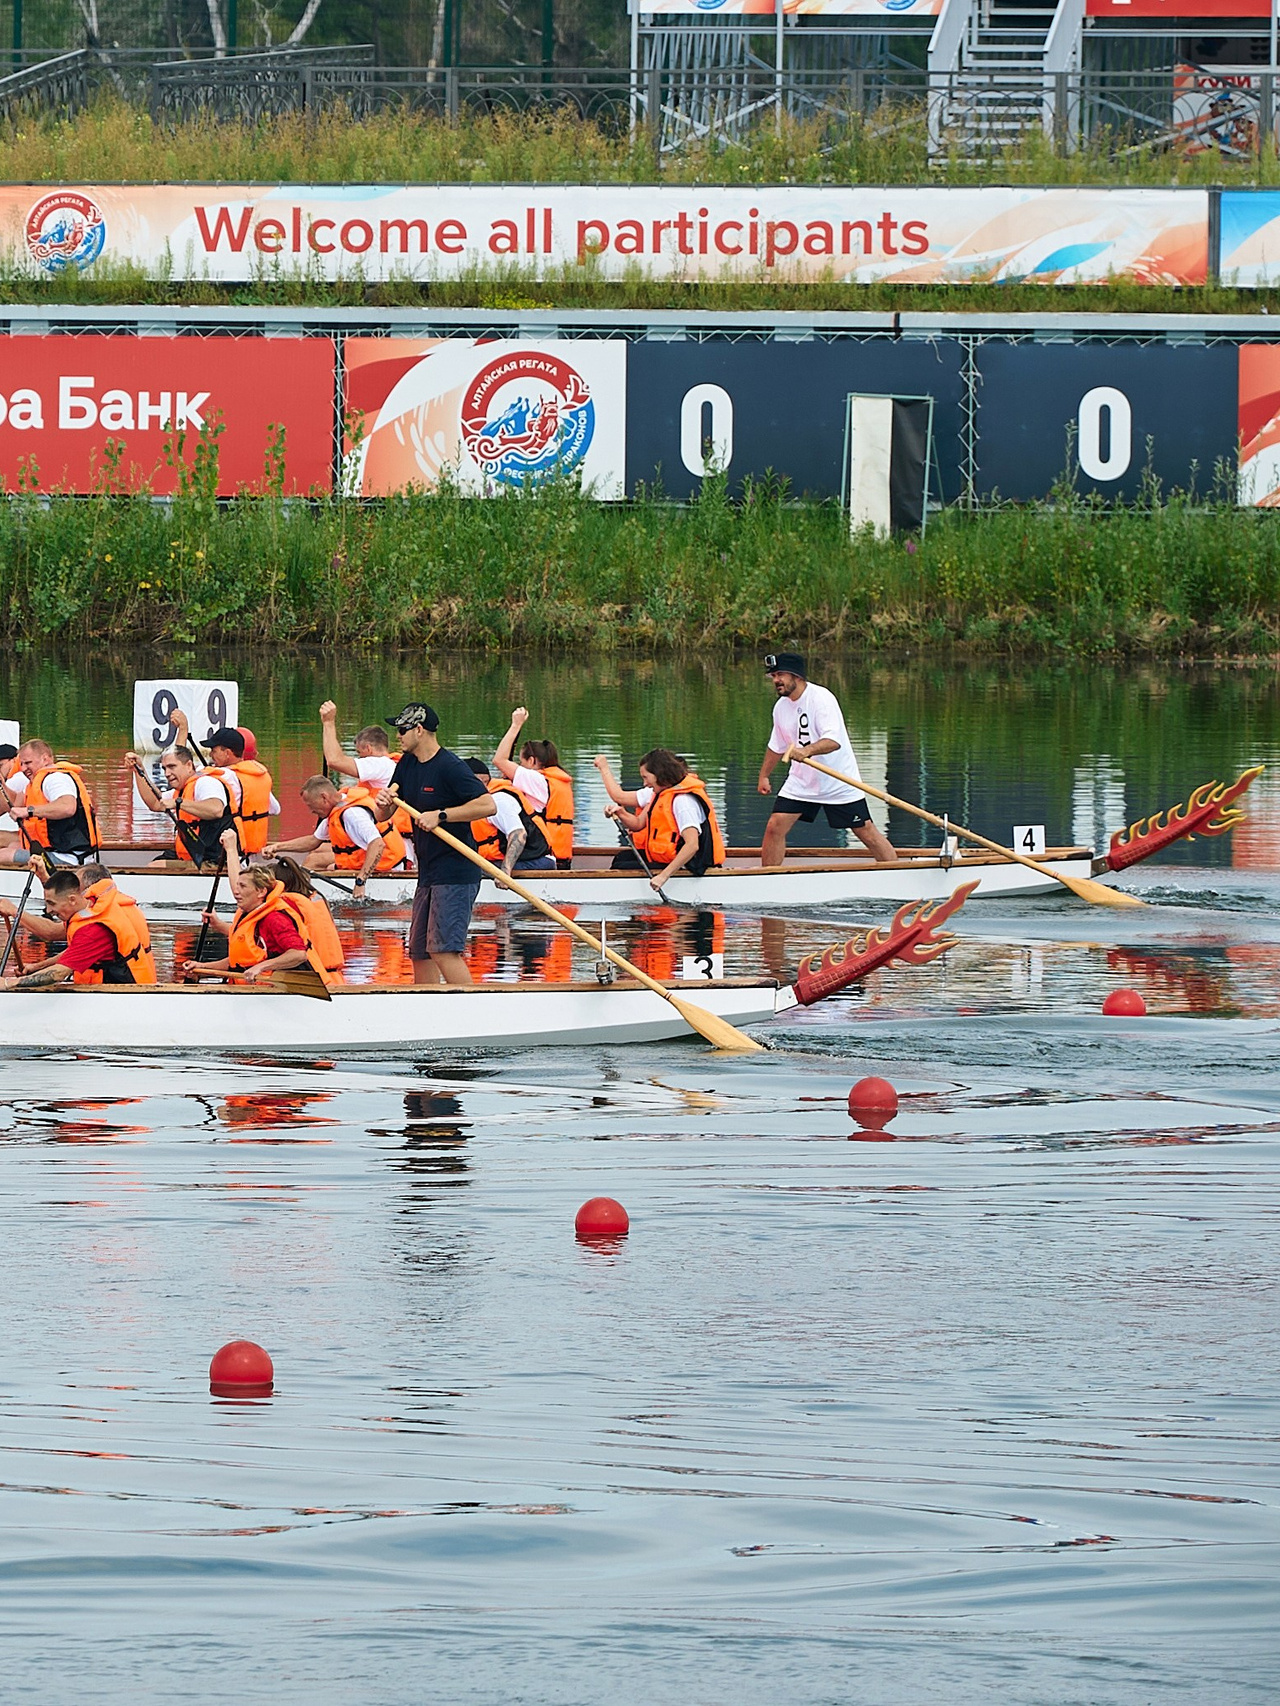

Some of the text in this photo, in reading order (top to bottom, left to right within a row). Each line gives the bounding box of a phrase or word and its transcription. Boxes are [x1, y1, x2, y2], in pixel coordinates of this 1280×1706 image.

[195, 207, 930, 267] Welcome all participants
[58, 376, 212, 431] Банк
[471, 359, 559, 411] АЛТАЙСКАЯ РЕГАТА
[681, 384, 733, 477] 0
[1078, 387, 1132, 481] 0
[152, 689, 178, 749] 9
[207, 689, 227, 741] 9
[1023, 828, 1036, 852] 4
[694, 955, 714, 980] 3
